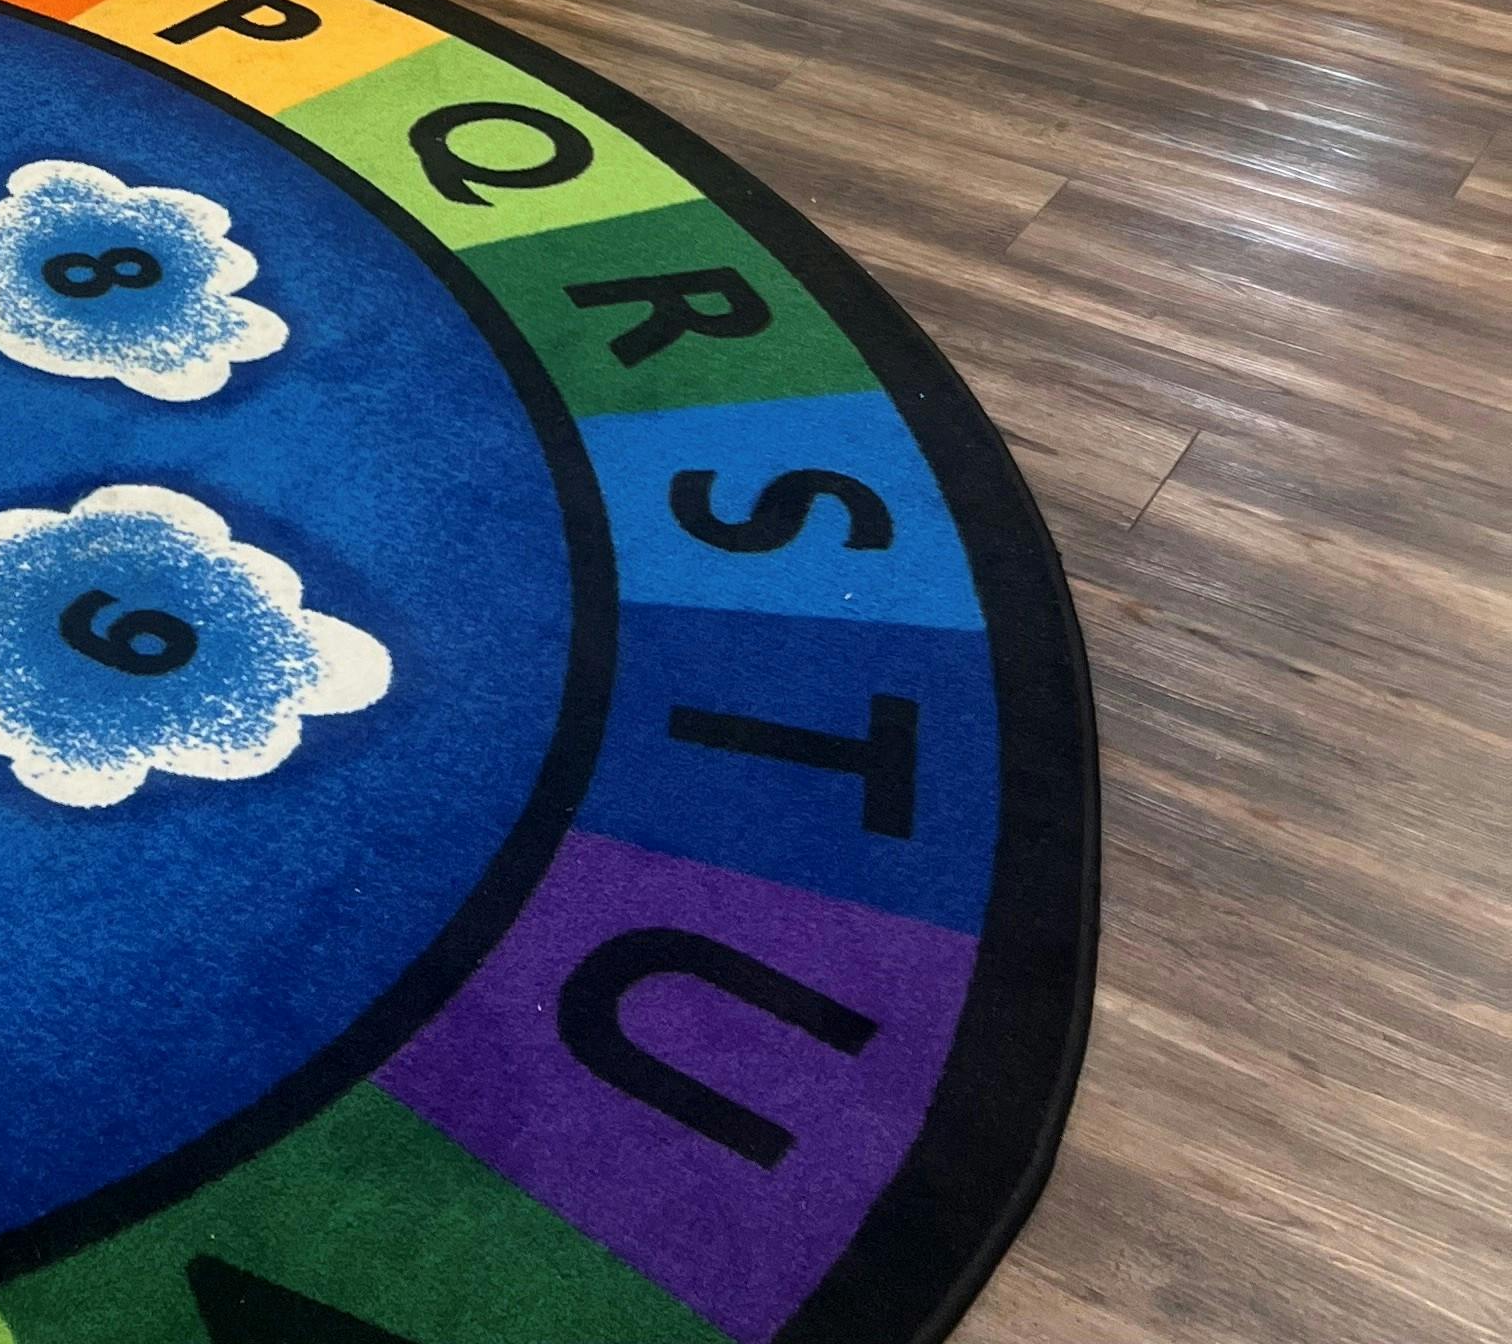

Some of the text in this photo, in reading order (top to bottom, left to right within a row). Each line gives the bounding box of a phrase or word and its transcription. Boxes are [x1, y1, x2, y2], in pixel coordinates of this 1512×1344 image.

[410, 102, 592, 205] Q
[42, 247, 162, 298] 8
[562, 266, 773, 369] R
[669, 469, 894, 553] S
[59, 589, 198, 676] 9
[669, 693, 920, 840] T
[555, 925, 877, 1171] U
